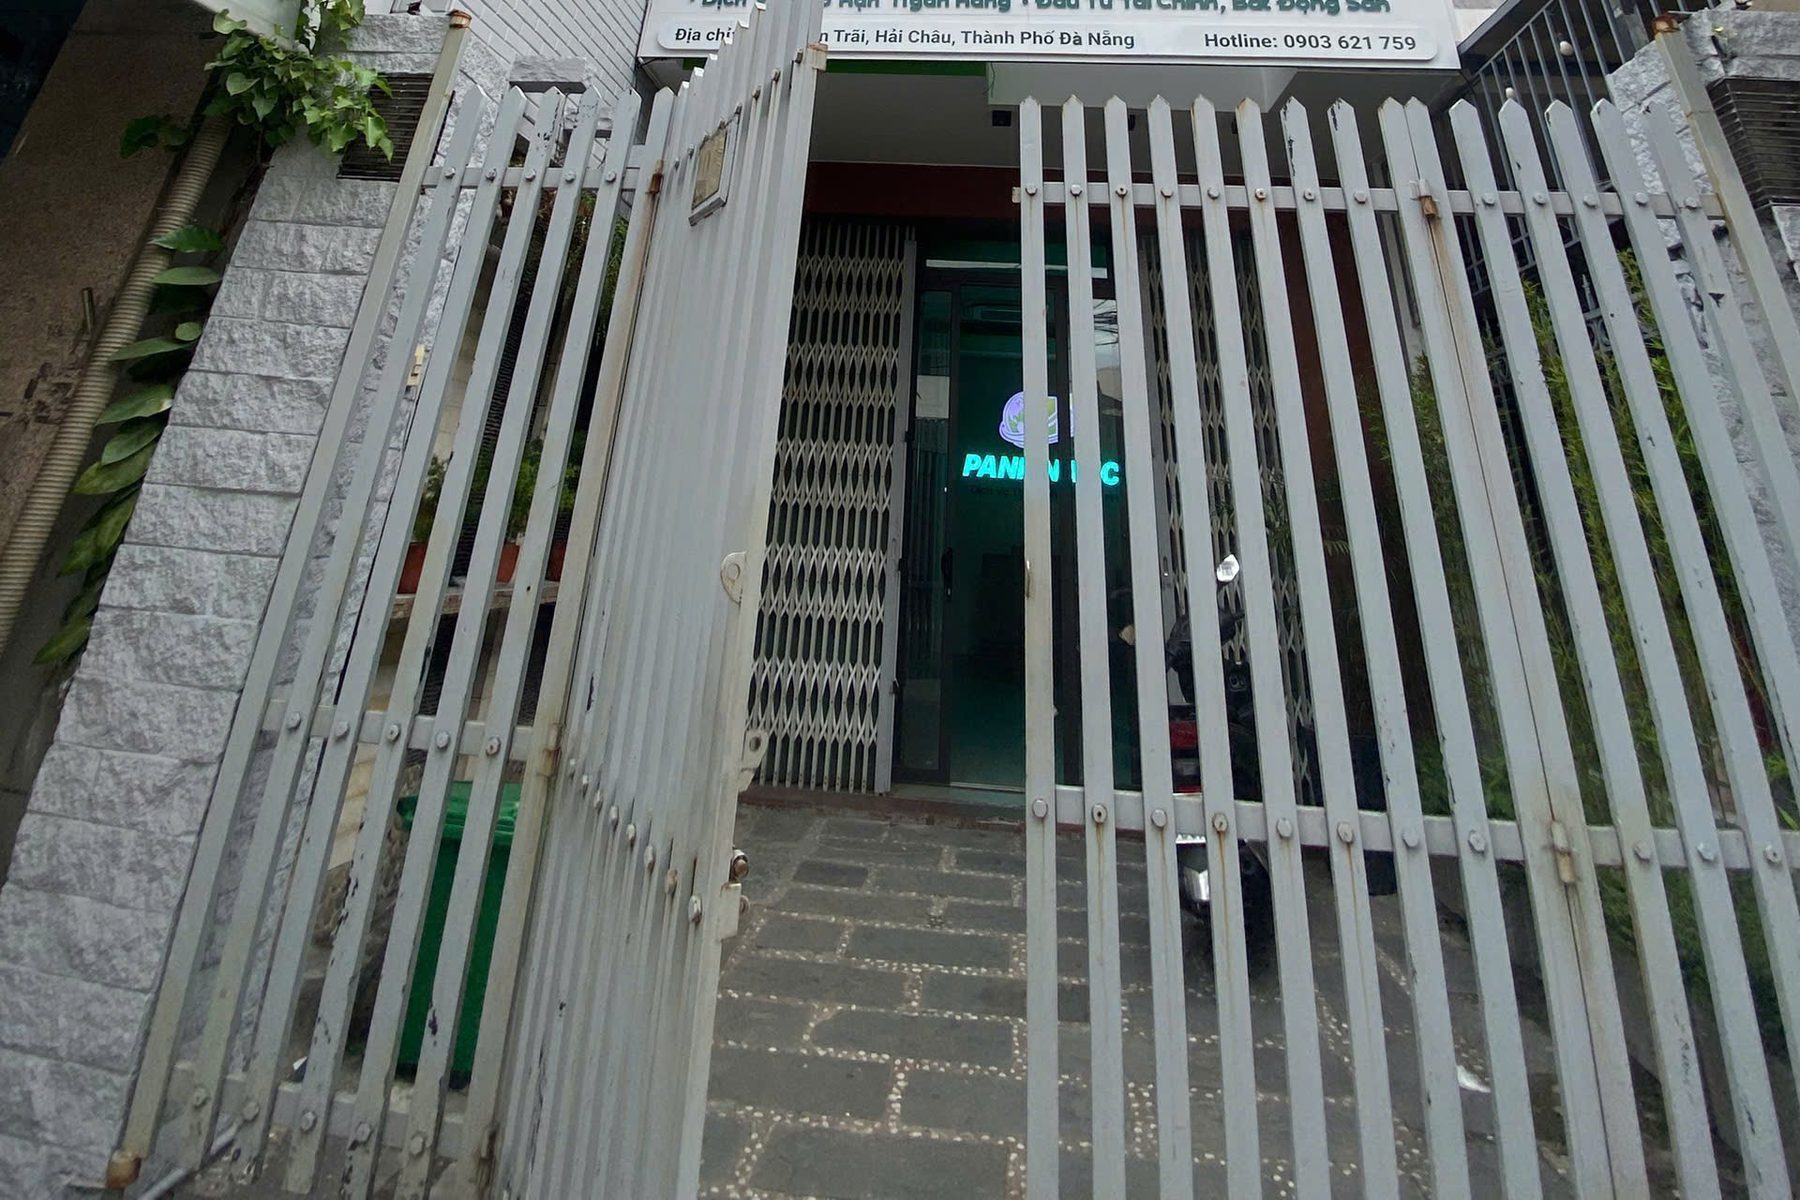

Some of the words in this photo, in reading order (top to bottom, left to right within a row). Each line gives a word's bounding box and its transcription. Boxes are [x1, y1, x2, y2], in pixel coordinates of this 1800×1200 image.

[675, 28, 701, 43] Địa
[875, 28, 903, 43] Hải
[908, 29, 956, 46] Châu,
[961, 30, 1014, 44] Thành
[1020, 30, 1055, 45] Phố
[1059, 31, 1083, 46] Đà
[1204, 33, 1278, 48] Hotline:
[1284, 34, 1332, 49] 0903
[1338, 35, 1372, 50] 621
[1379, 35, 1416, 50] 759
